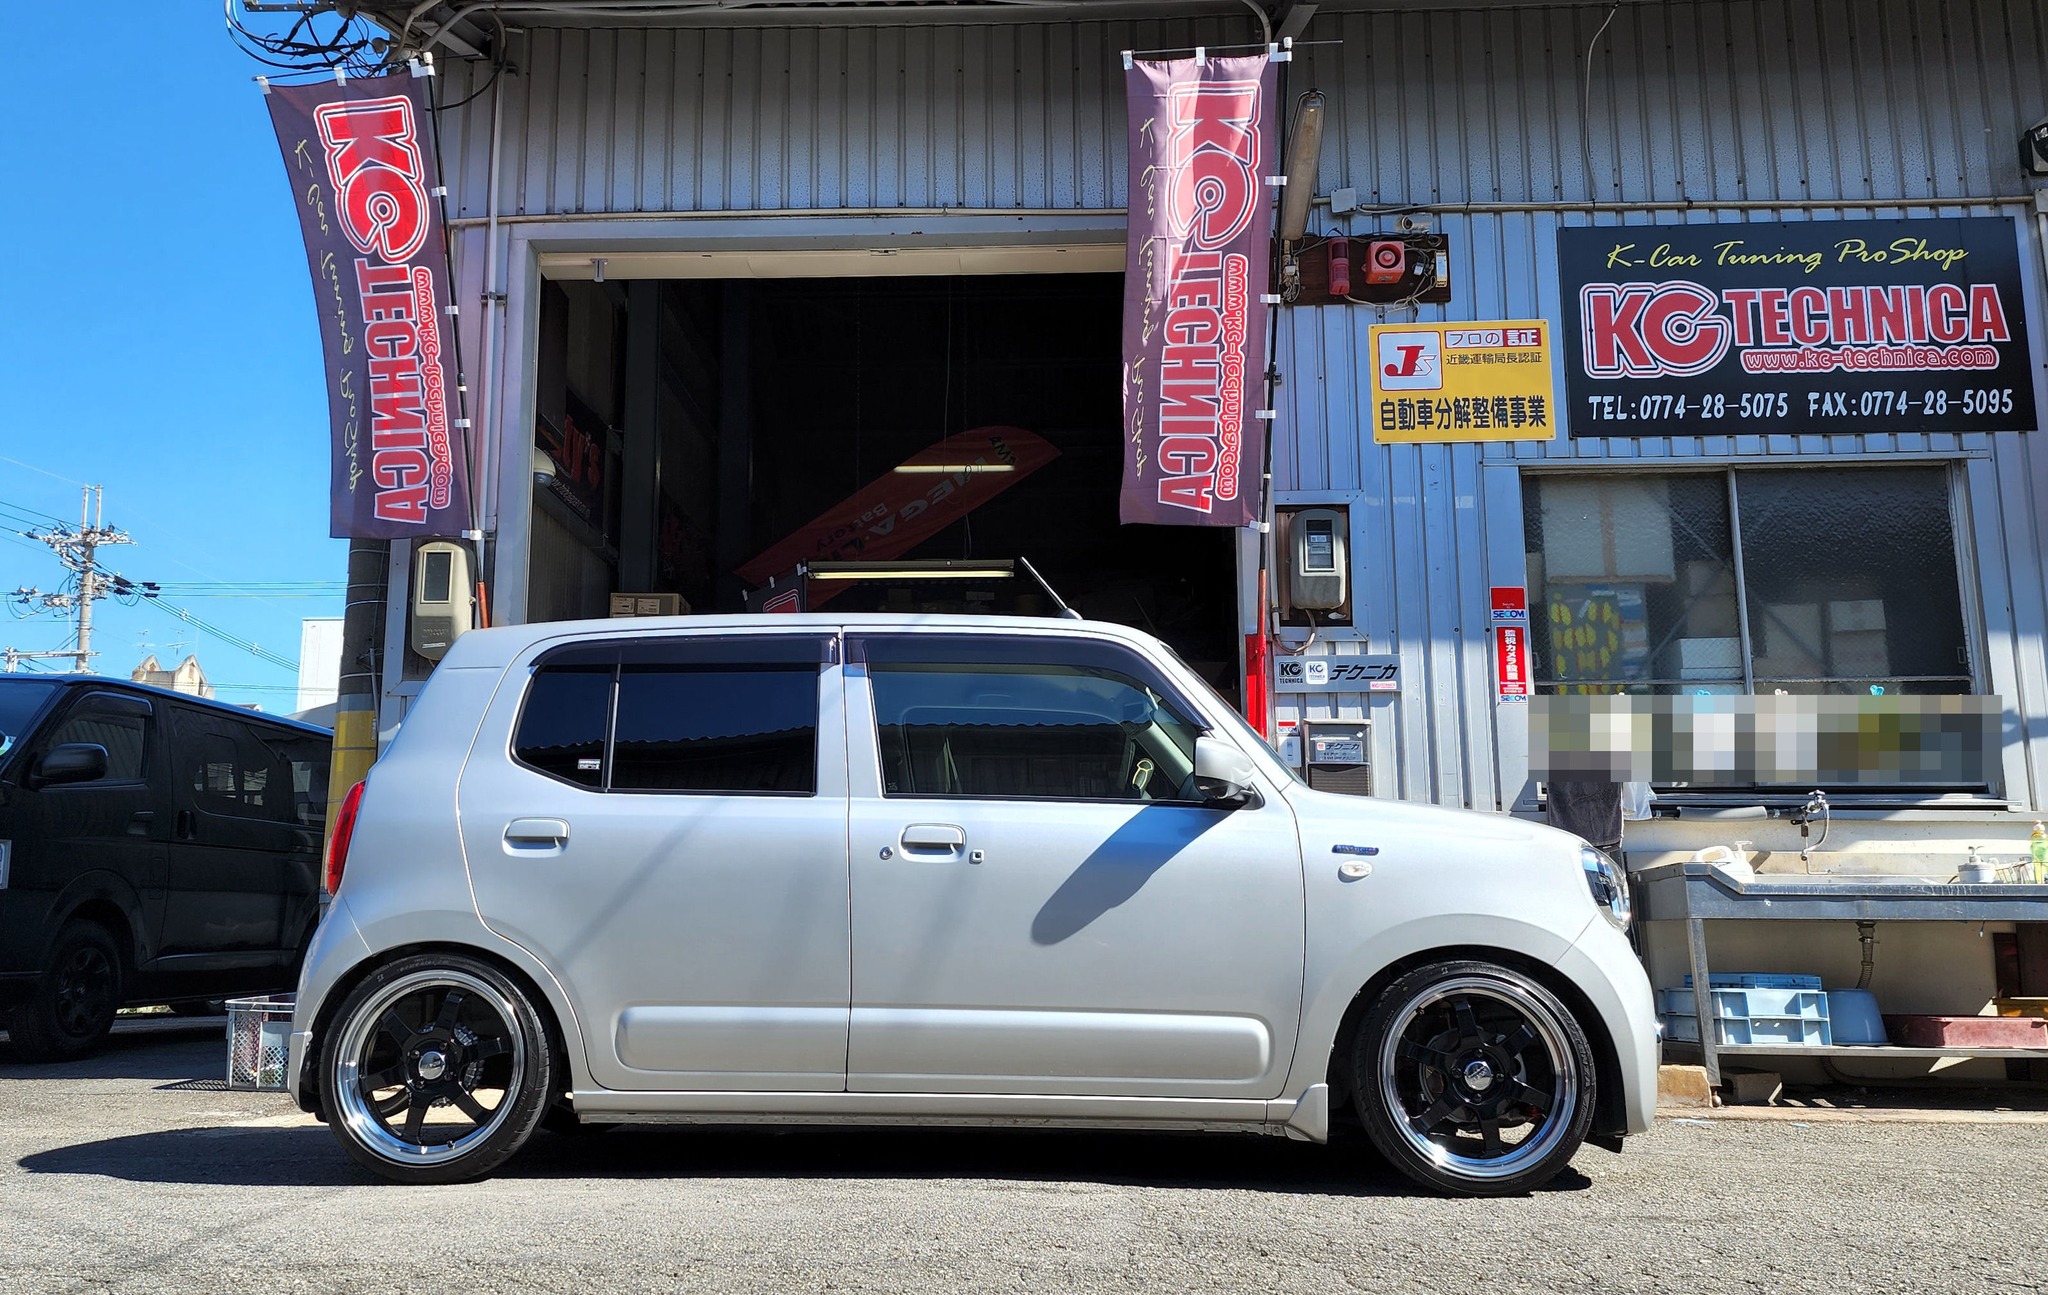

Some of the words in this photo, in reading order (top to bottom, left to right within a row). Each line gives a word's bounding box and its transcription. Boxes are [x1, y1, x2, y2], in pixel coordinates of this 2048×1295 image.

[1607, 243, 1702, 269] K-Car
[1713, 240, 1823, 274] Tuning
[1450, 329, 1540, 347] プロの証
[1580, 280, 1733, 380] KC
[1722, 283, 2011, 346] TECHNICA
[1446, 352, 1542, 365] 近畿運輸局長認証
[1743, 345, 1997, 371] www.kc-technica.com
[1381, 395, 1546, 431] 自動車分解整備事業
[1588, 392, 1788, 420] TEL:0774-28-5075
[1808, 388, 2014, 418] FAX:0774-28-5095
[1493, 610, 1525, 618] SECOM
[1329, 664, 1398, 680] テクニカ
[1501, 694, 1526, 702] SECOM
